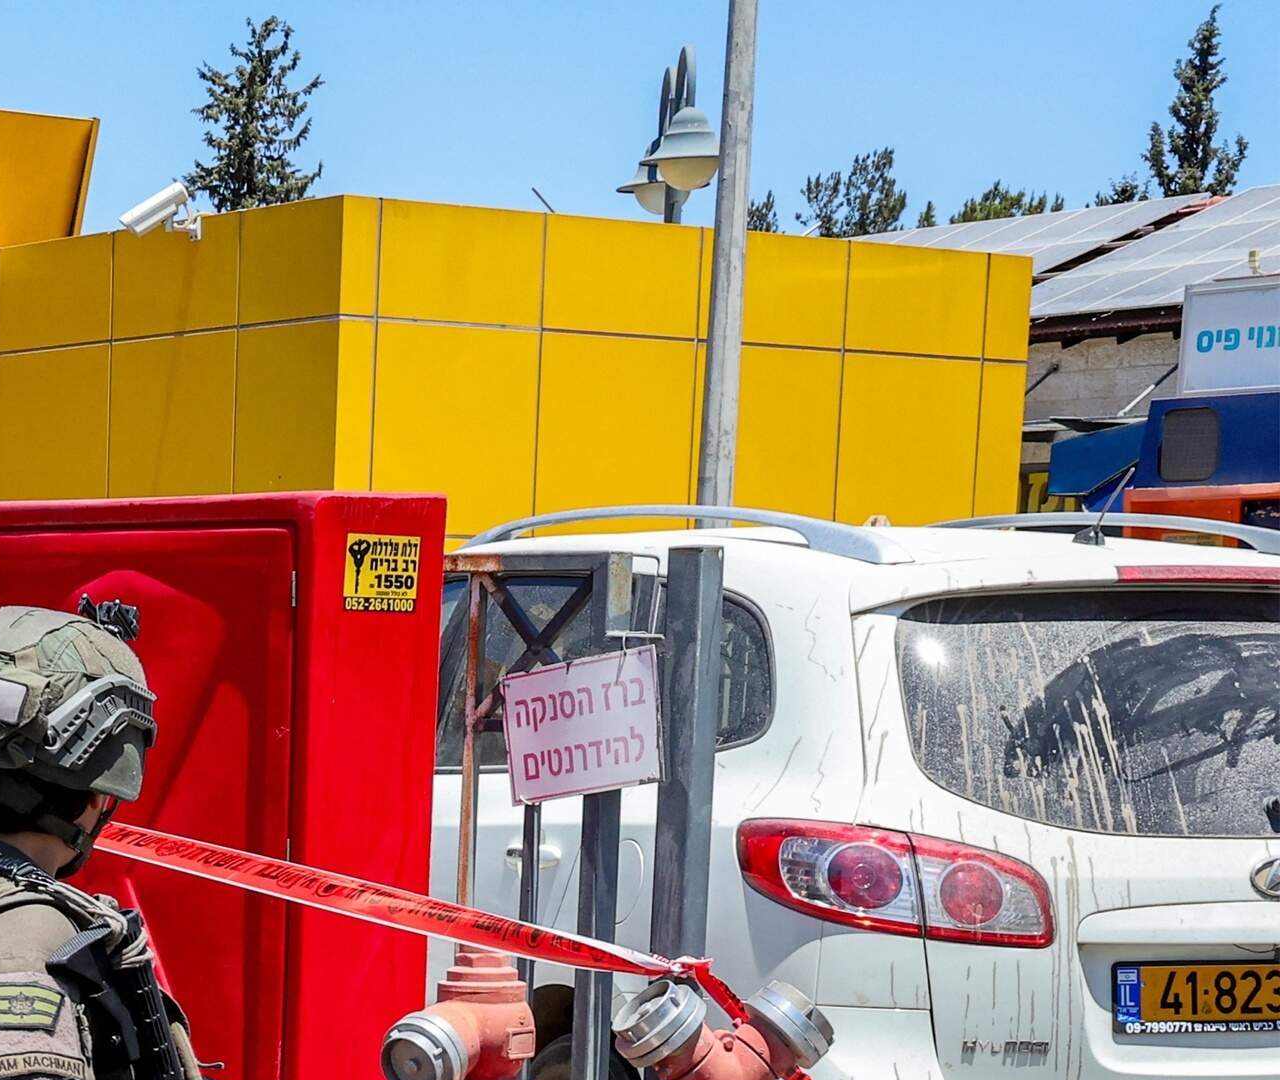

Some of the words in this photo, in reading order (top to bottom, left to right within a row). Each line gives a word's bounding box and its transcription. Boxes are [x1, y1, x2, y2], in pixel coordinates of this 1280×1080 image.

[1196, 326, 1241, 353] פיס
[401, 539, 418, 557] דלת
[370, 558, 399, 572] בריח
[402, 559, 417, 573] רב
[374, 574, 415, 590] 1550
[345, 597, 414, 612] 052-2641000
[601, 677, 646, 711] ברז
[515, 686, 594, 733] הסנקה
[523, 725, 646, 781] להידרנטים
[1120, 985, 1135, 1006] IL
[1126, 1022, 1192, 1034] 09-7990771
[23, 1055, 81, 1075] NACHMAN
